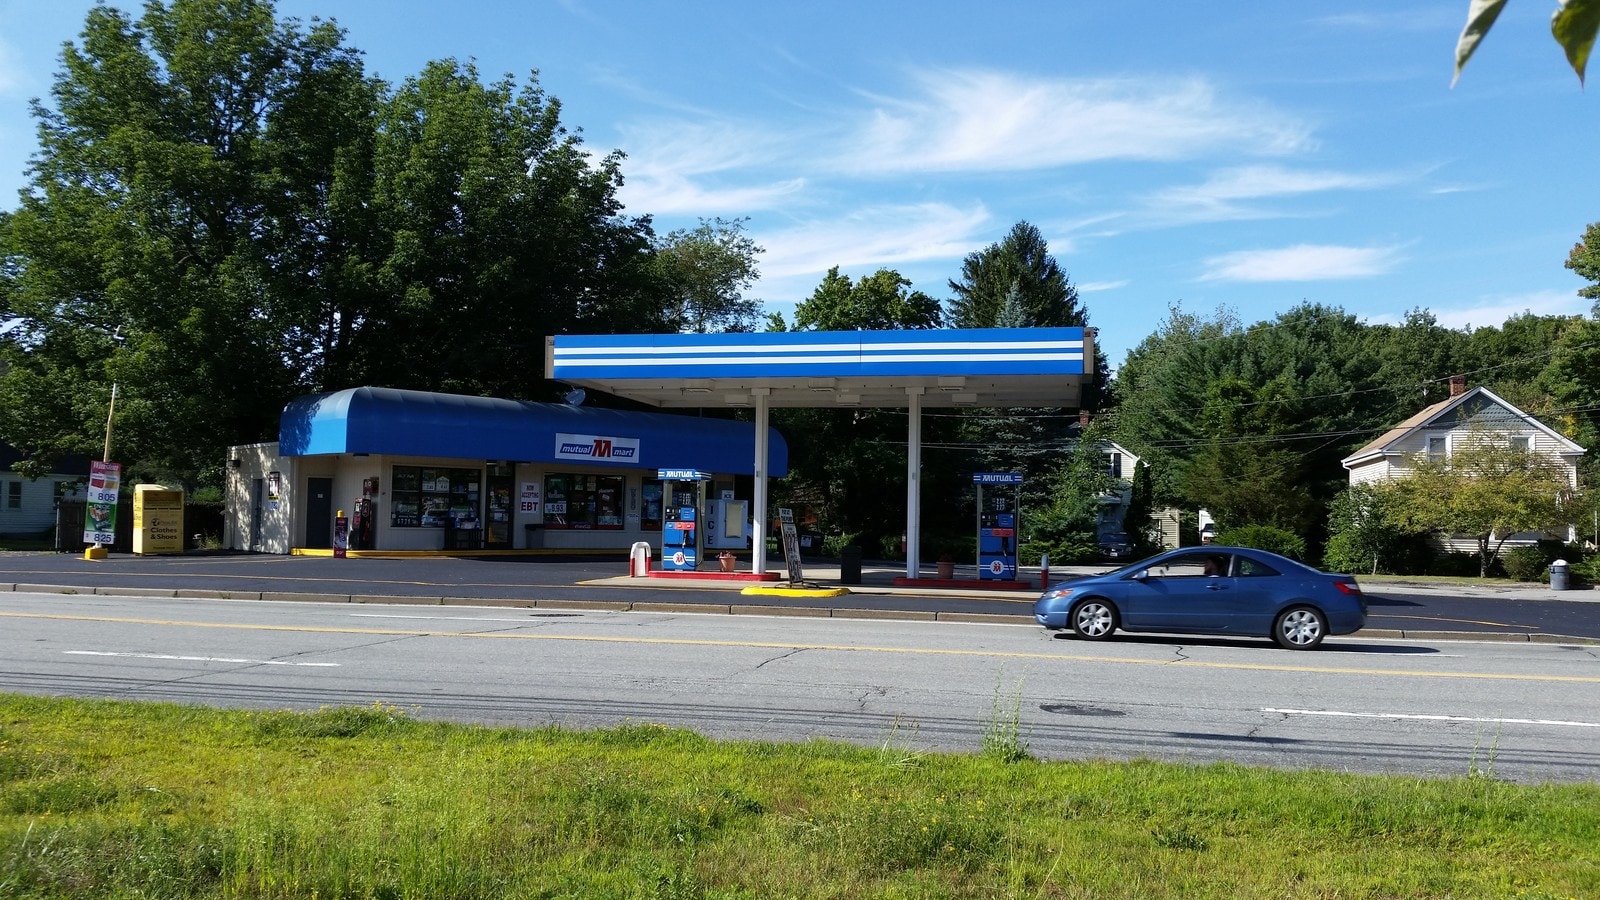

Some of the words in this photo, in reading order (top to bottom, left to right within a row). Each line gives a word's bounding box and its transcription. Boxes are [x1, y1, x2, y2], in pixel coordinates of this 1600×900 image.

[562, 445, 591, 454] mutual
[591, 440, 611, 457] M
[666, 470, 694, 478] MUTUAL
[982, 474, 1013, 482] MUTUAL
[521, 502, 538, 511] EBT
[94, 533, 112, 543] 825
